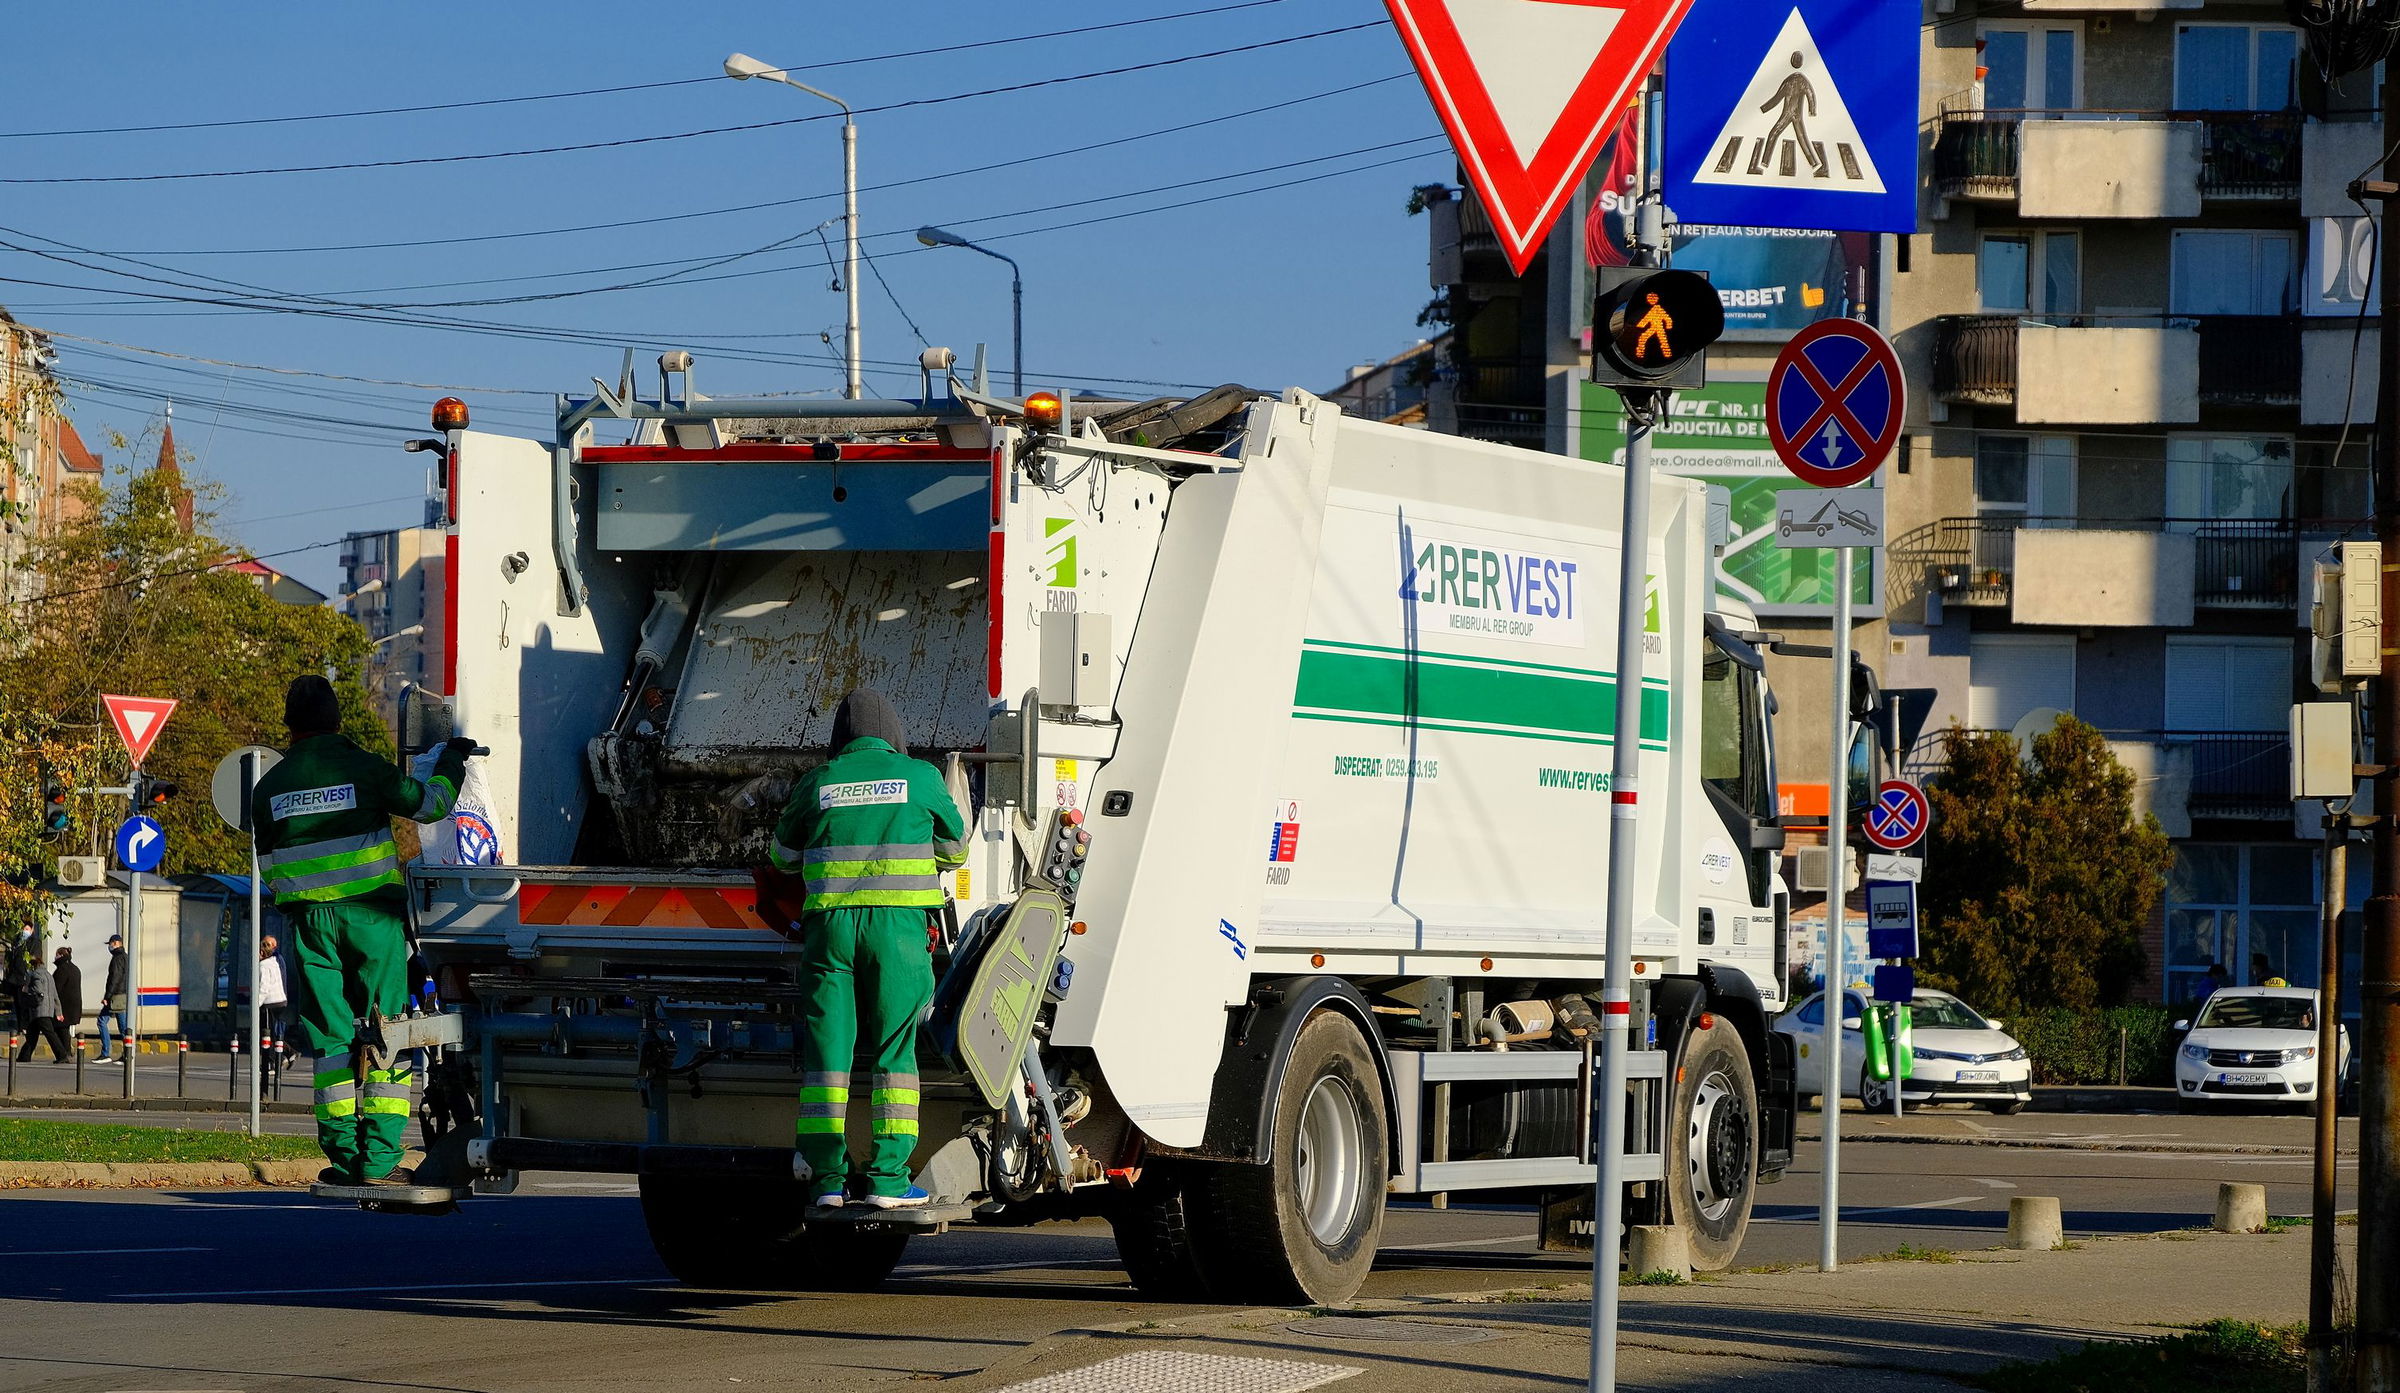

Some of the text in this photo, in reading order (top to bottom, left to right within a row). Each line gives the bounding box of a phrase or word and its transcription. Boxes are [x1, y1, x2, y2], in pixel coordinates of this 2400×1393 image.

[1717, 285, 1786, 307] ERBET
[1721, 403, 1748, 417] NR.
[1736, 422, 1757, 436] DE
[1046, 589, 1078, 613] FARID
[1449, 613, 1534, 637] MEMBRU AL RER GROUP
[1642, 634, 1662, 655] FARID
[1334, 755, 1383, 778] DISPECERAT:
[1265, 866, 1291, 886] FARID
